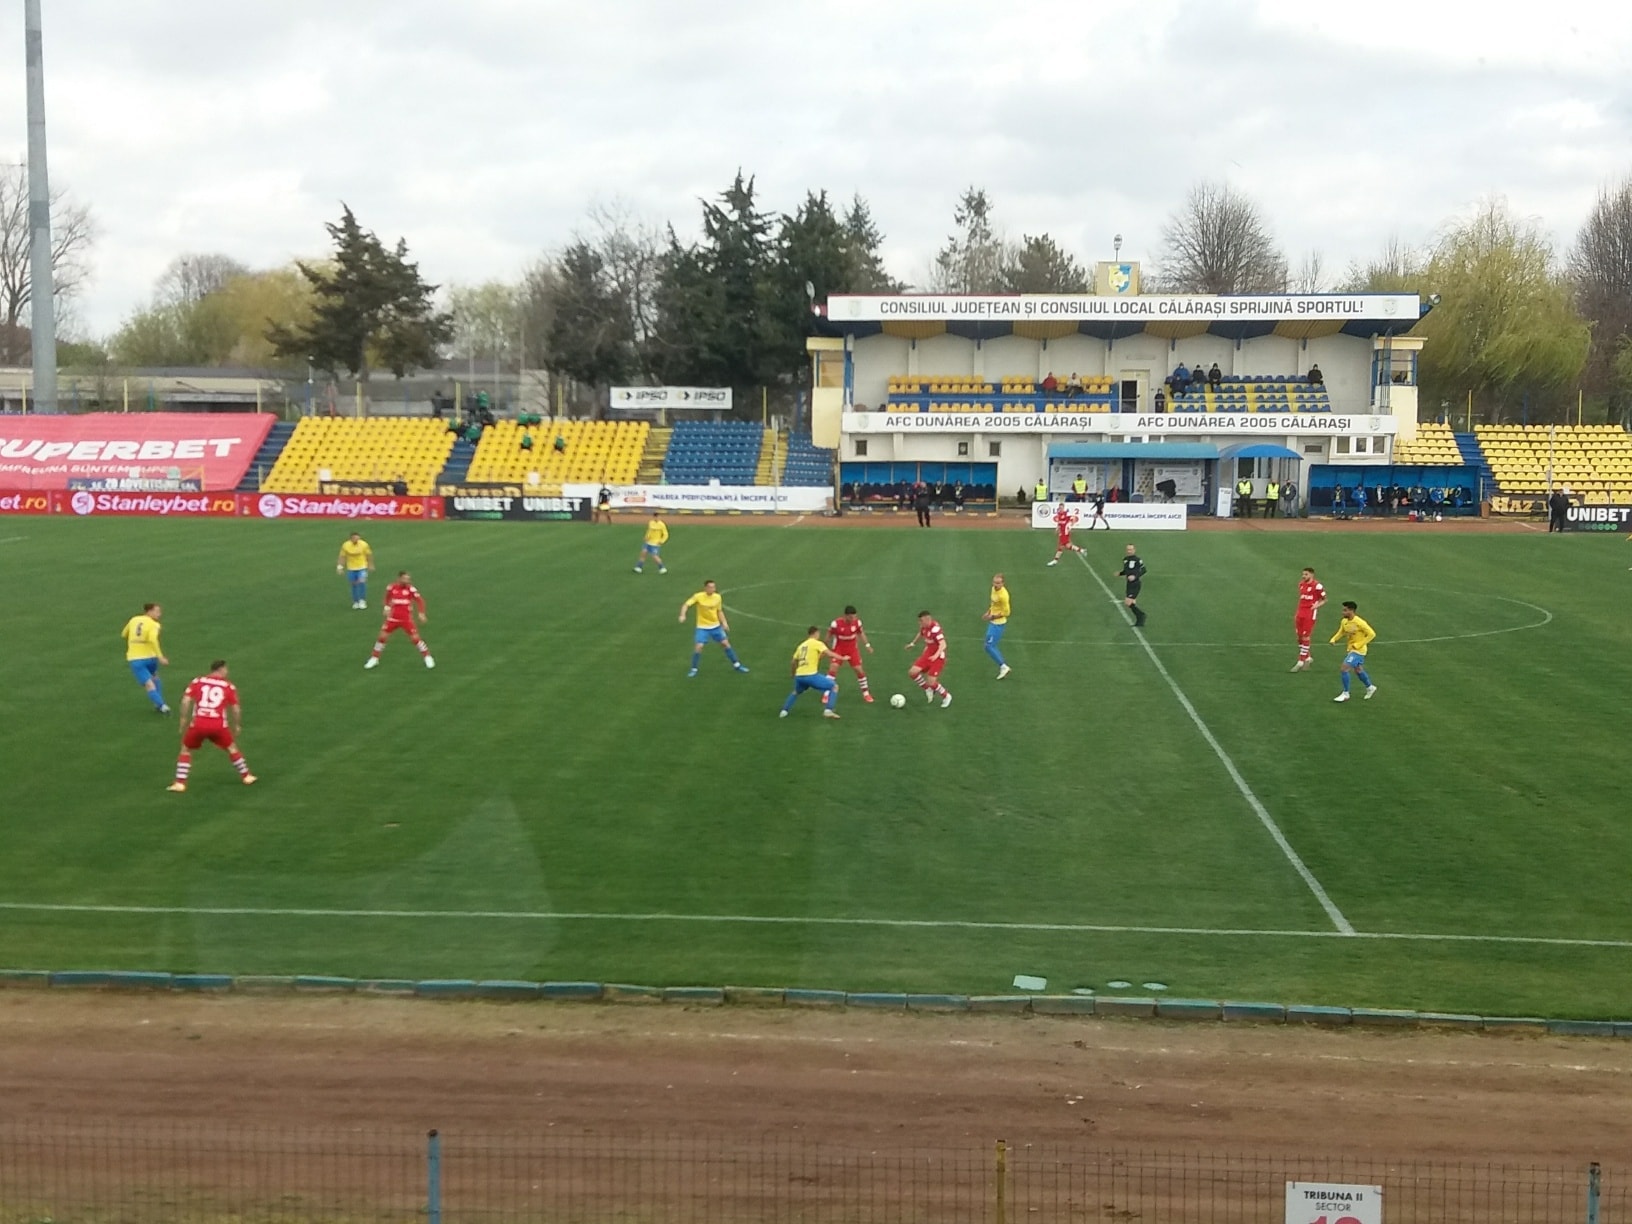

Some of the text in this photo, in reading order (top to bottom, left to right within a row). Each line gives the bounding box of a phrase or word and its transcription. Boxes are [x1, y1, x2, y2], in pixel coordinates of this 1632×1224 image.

[880, 301, 948, 314] CONSILIUL
[951, 301, 1021, 318] JUDEȚEAN
[1040, 301, 1110, 314] CONSILIUL
[1113, 301, 1155, 314] LOCAL
[1158, 298, 1226, 318] CĂLĂRAȘI
[1230, 298, 1293, 314] SPRIJINĂ
[1297, 300, 1364, 313] SPORTUL!
[885, 413, 1092, 430] AFC DUNĂREA 2005 CĂLĂRAȘI
[1137, 414, 1351, 431] AFC DUNĂREA 2005 CĂLĂRAȘI
[0, 437, 242, 462] UPERBET
[96, 494, 235, 515] Stanleybet.ro
[284, 497, 425, 518] Stanleybet.ro
[453, 497, 514, 511] UNIBET
[522, 497, 583, 512] UNIBET
[1566, 507, 1631, 522] UNIBET
[198, 684, 224, 709] 19
[1304, 1190, 1353, 1201] TRIBUNA
[1315, 1202, 1352, 1212] SECTOR
